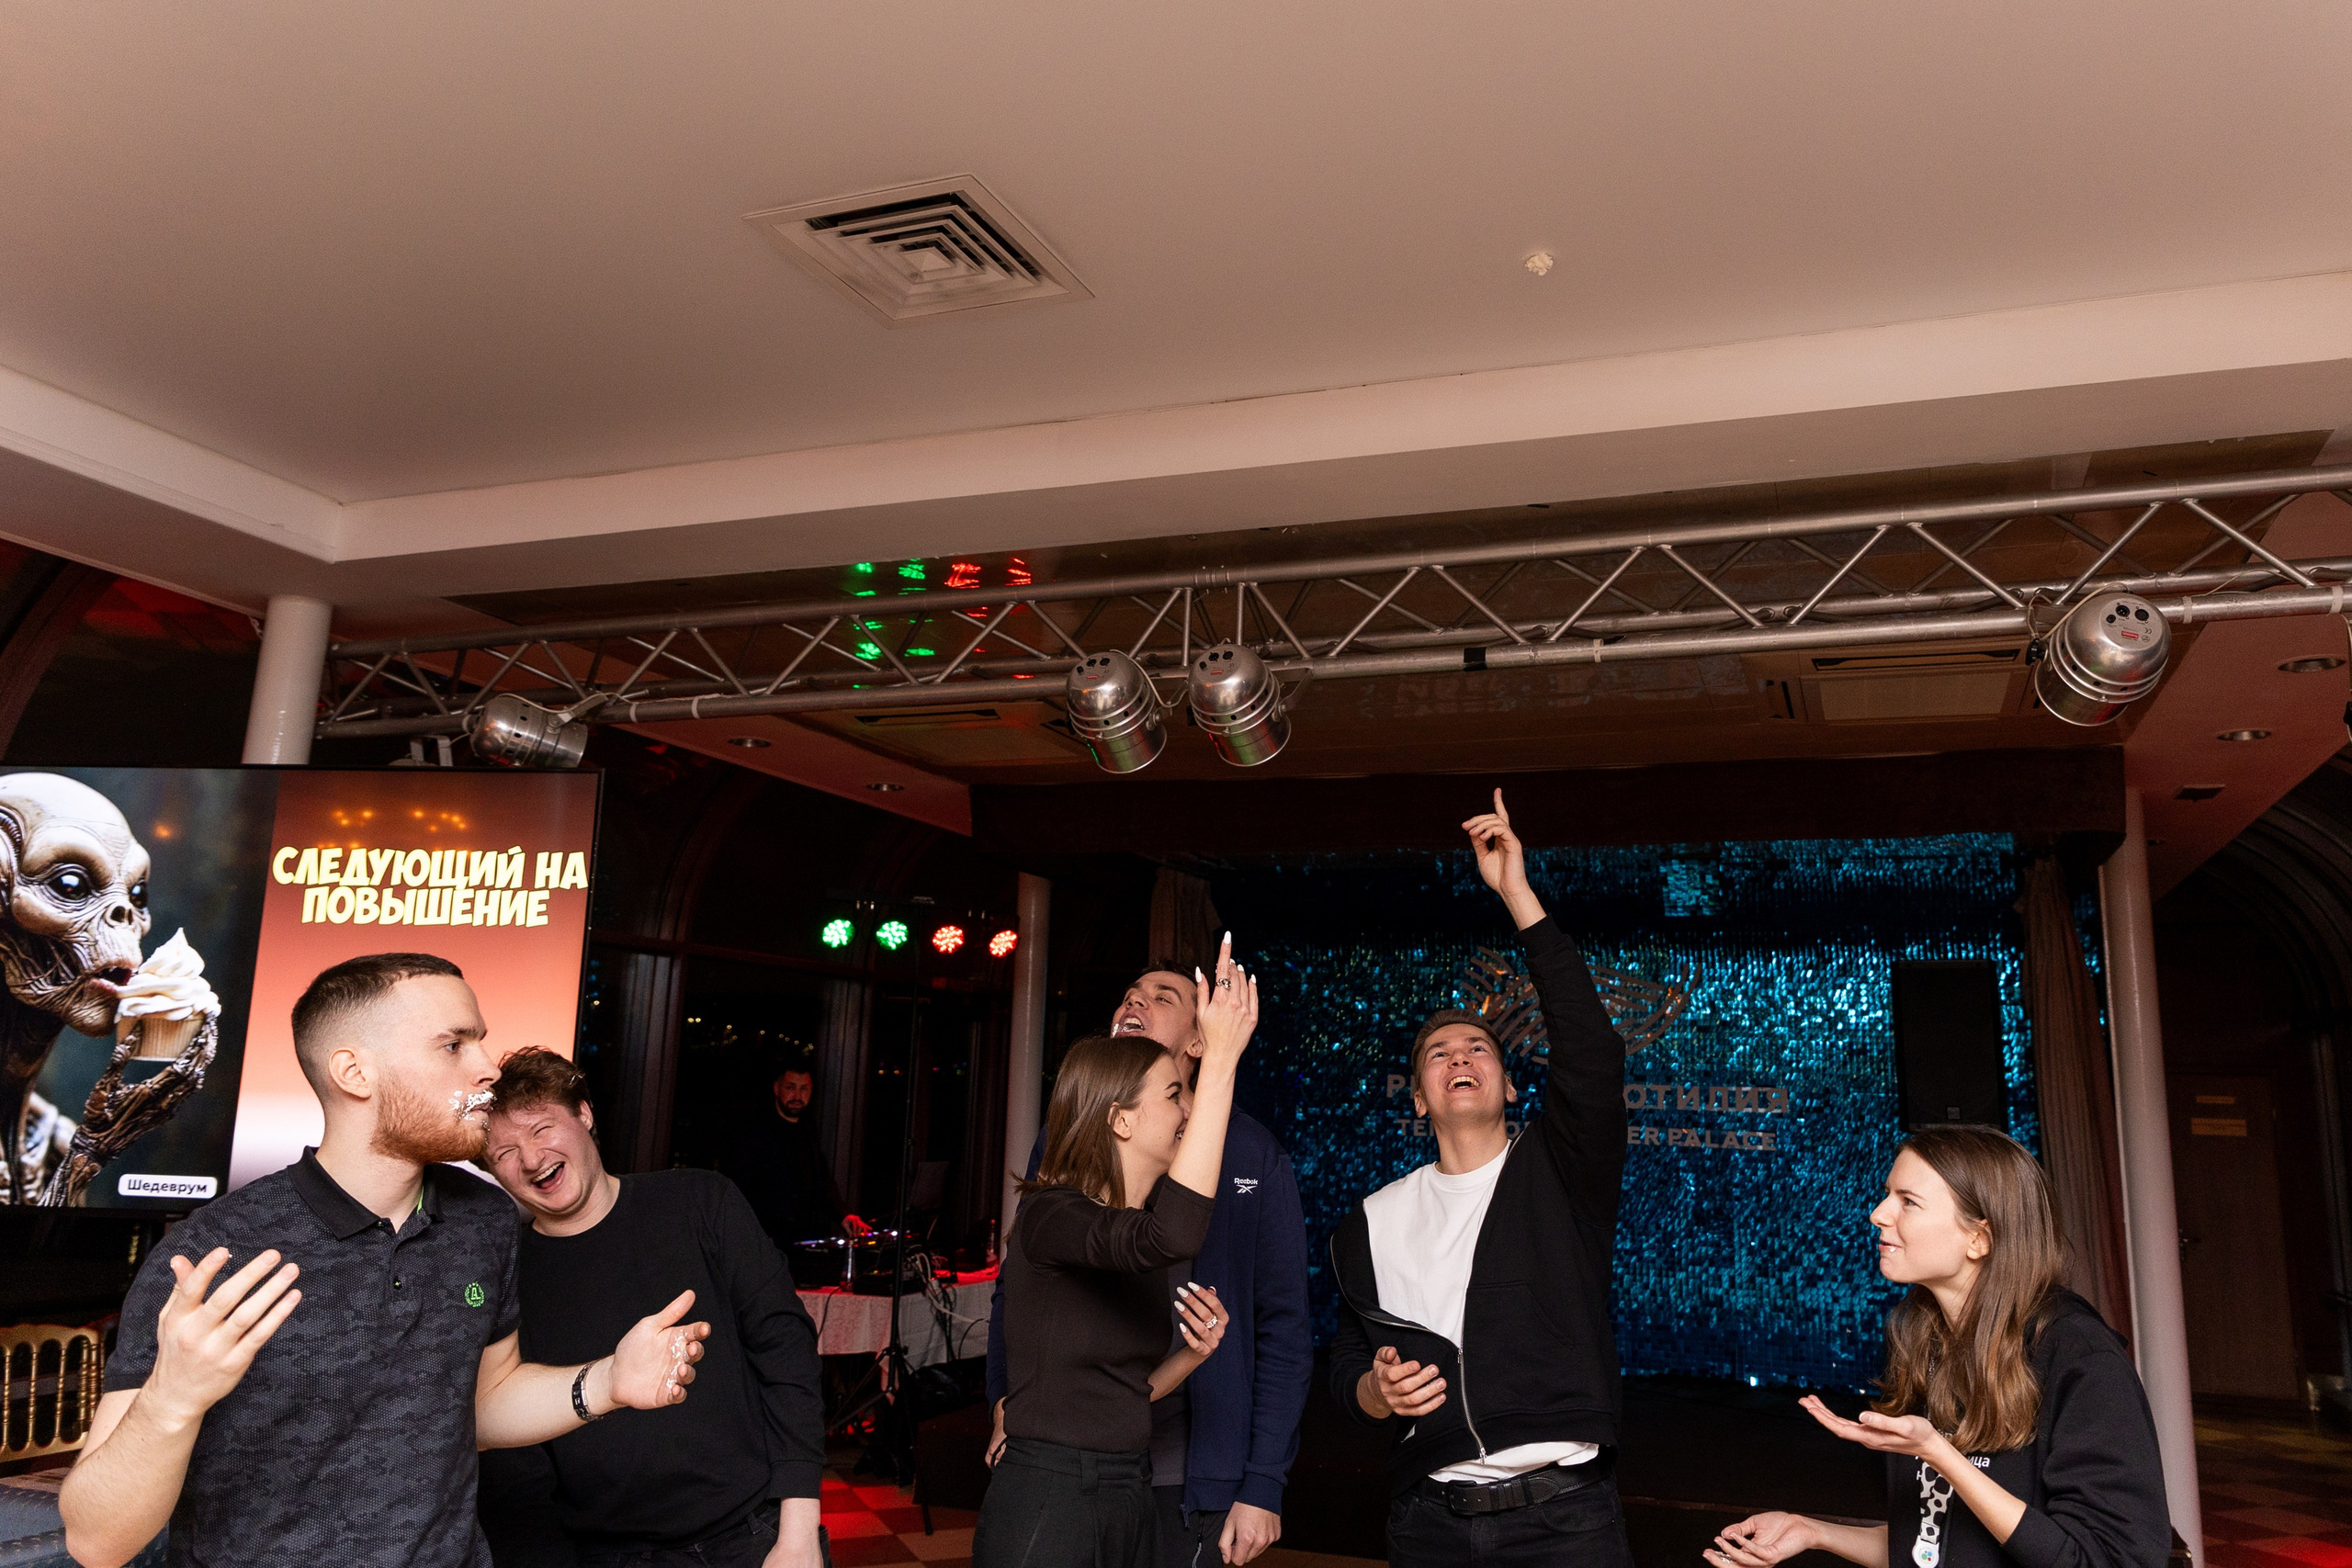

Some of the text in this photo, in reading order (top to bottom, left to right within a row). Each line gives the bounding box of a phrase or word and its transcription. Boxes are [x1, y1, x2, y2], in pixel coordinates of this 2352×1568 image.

[272, 845, 590, 890] СЛЕДУЮЩИЙ НА
[300, 886, 551, 929] ПОВЫШЕНИЕ
[1623, 1083, 1789, 1113] ОТИЛИЯ
[1668, 1128, 1778, 1151] PALACE
[127, 1179, 208, 1195] Шедеврум
[1234, 1177, 1259, 1185] Reebok
